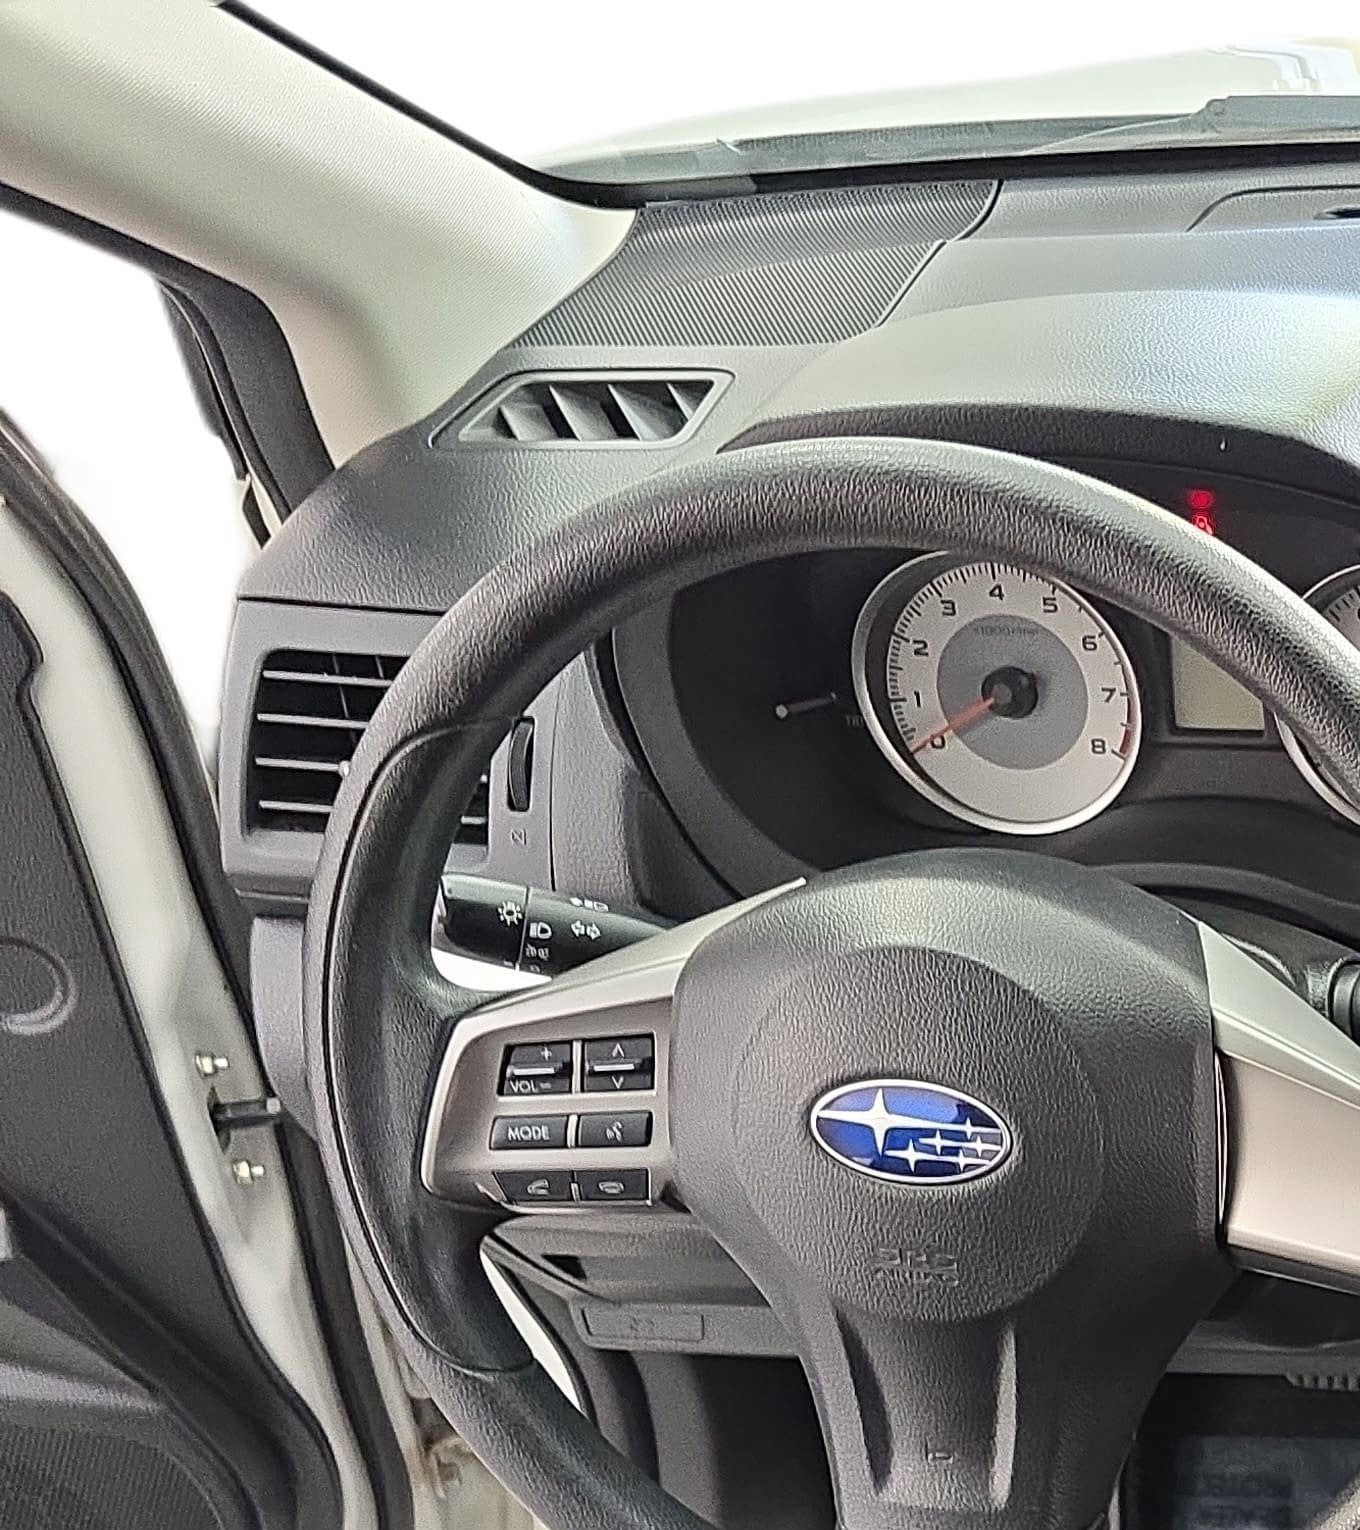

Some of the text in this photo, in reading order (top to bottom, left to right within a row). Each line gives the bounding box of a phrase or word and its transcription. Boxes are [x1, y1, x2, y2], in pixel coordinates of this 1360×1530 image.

[989, 584, 1005, 600] 4
[941, 600, 957, 617] 3
[1042, 597, 1058, 613] 5
[913, 640, 929, 657] 2
[1082, 635, 1098, 651] 6
[914, 690, 922, 707] 1
[1100, 687, 1116, 703] 7
[929, 733, 946, 750] 0
[1091, 739, 1106, 754] 8
[509, 1079, 538, 1093] VOL
[508, 1125, 551, 1141] MODE
